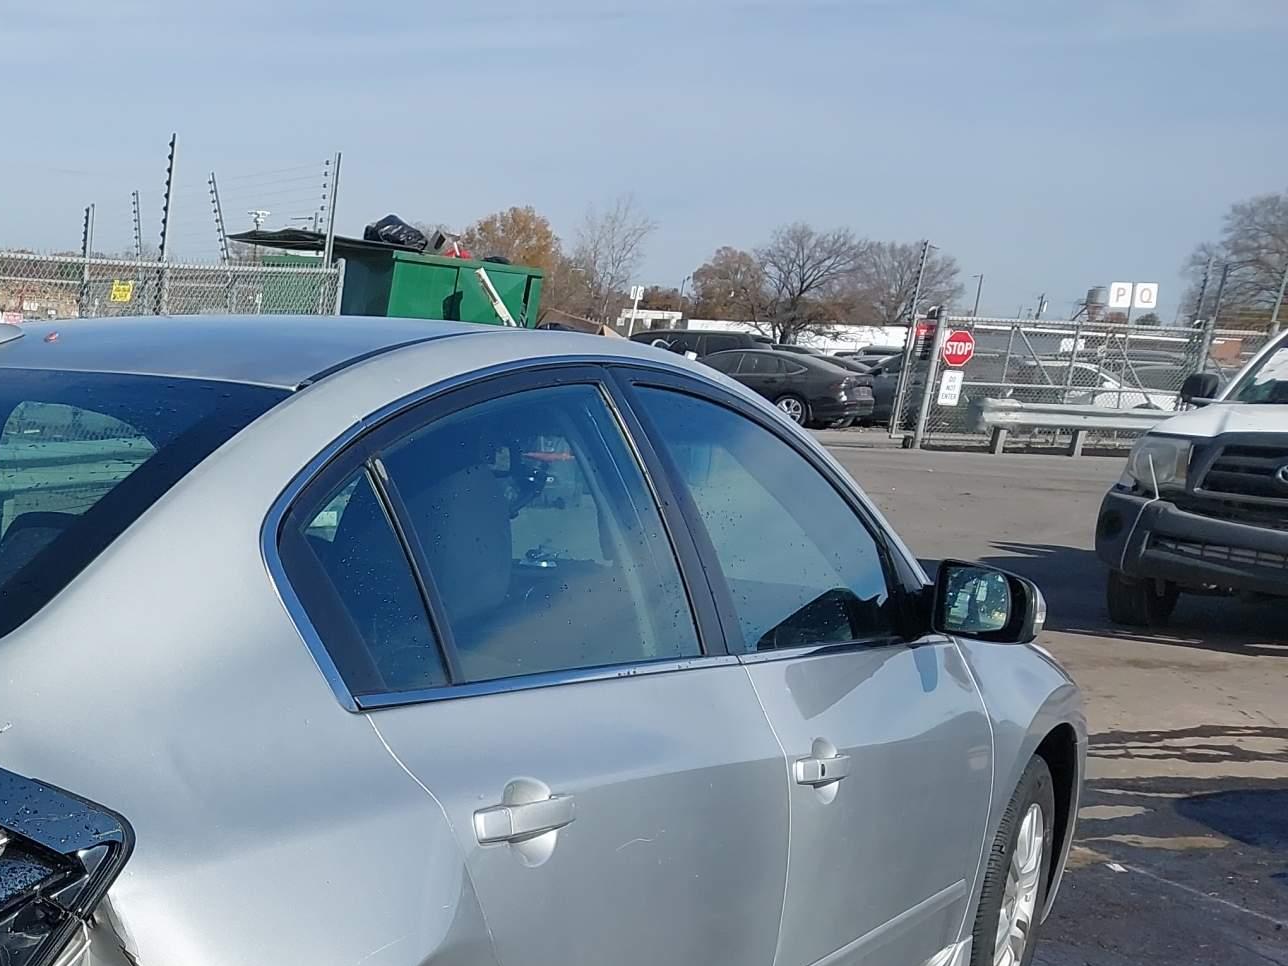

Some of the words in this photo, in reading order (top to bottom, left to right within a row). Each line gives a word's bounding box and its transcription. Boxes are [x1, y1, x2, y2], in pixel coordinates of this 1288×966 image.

[1115, 287, 1127, 303] P
[1139, 287, 1153, 304] Q
[945, 341, 972, 355] STOP
[945, 384, 956, 392] NOT
[941, 392, 957, 401] ENTER
